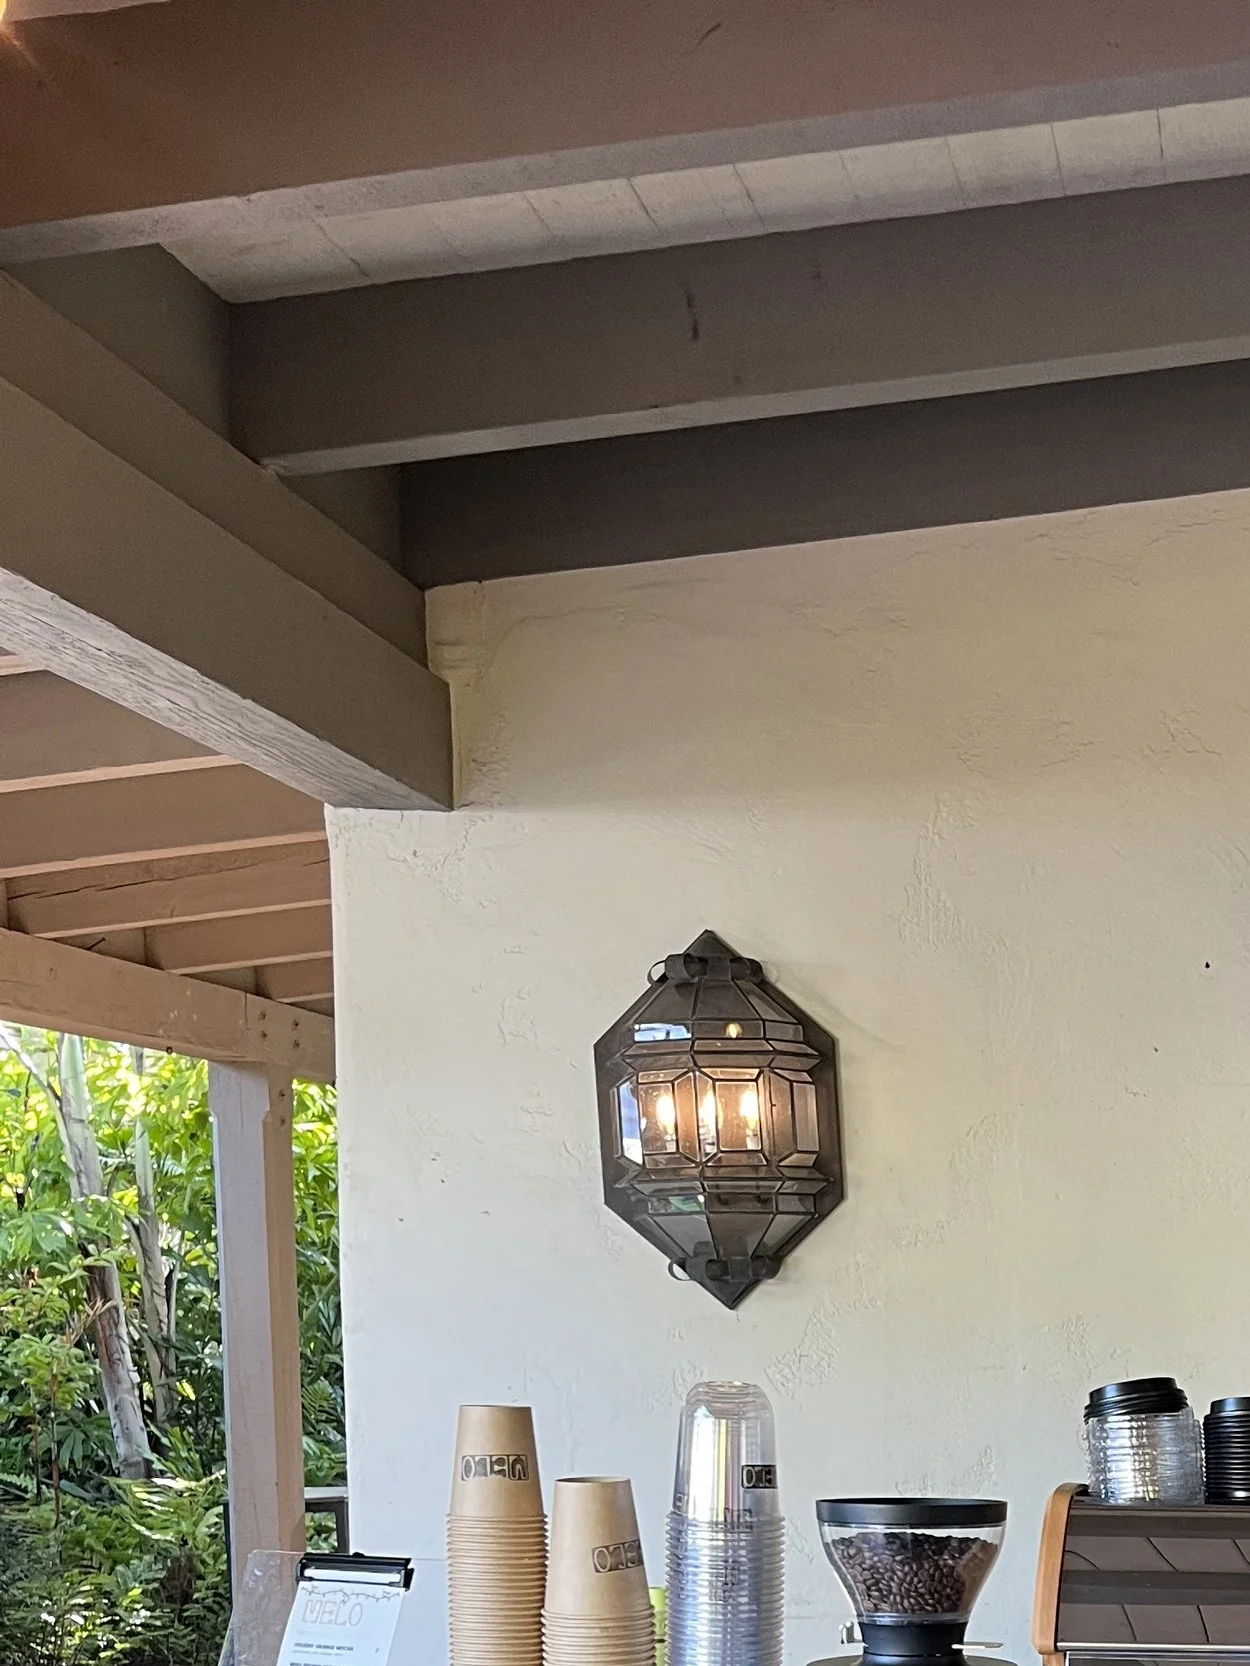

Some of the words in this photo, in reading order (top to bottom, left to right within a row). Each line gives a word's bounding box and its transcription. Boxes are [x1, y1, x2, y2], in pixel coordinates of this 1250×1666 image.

[462, 1455, 528, 1481] MELO
[593, 1540, 644, 1572] ELO
[301, 1599, 364, 1627] MELO
